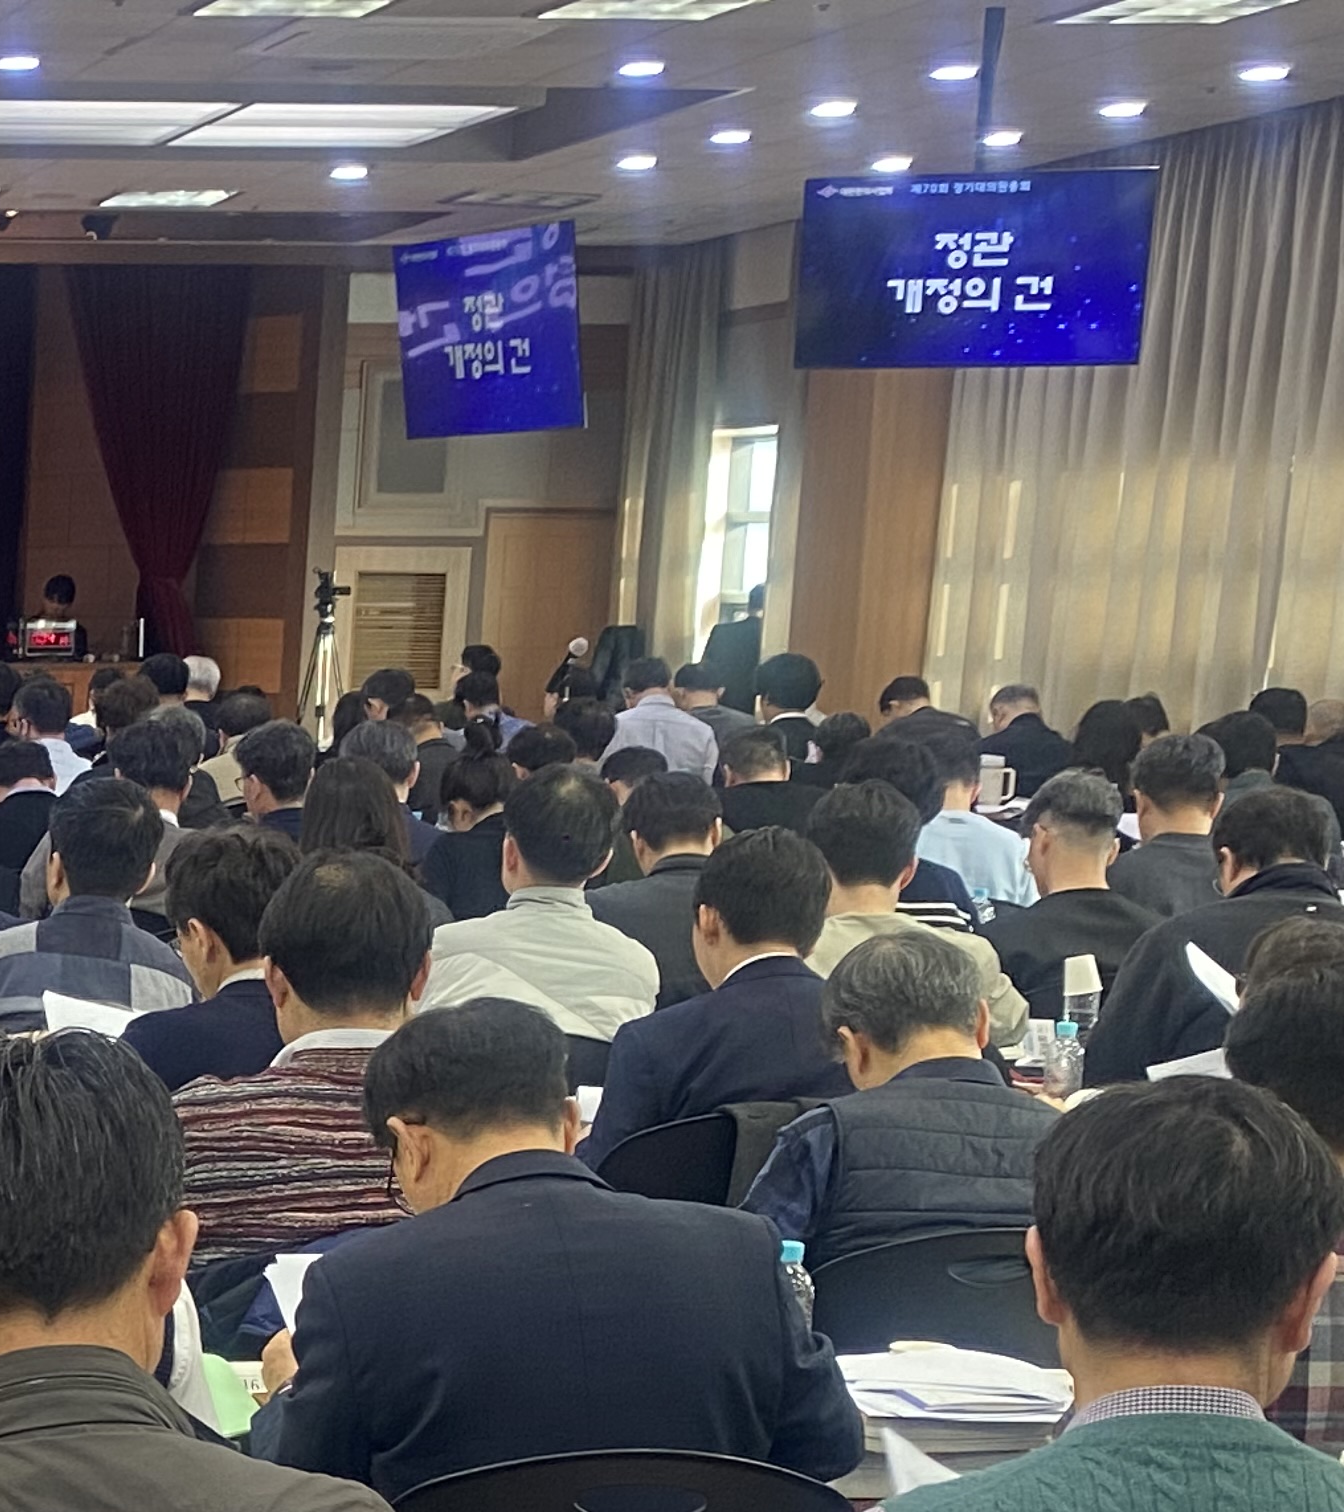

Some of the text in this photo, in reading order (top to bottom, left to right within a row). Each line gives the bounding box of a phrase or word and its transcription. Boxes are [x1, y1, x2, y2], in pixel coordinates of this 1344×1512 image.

[933, 231, 1014, 269] 정관
[463, 291, 505, 333] 정관
[886, 275, 1055, 315] 개정의 건
[443, 338, 532, 379] 개정의 건
